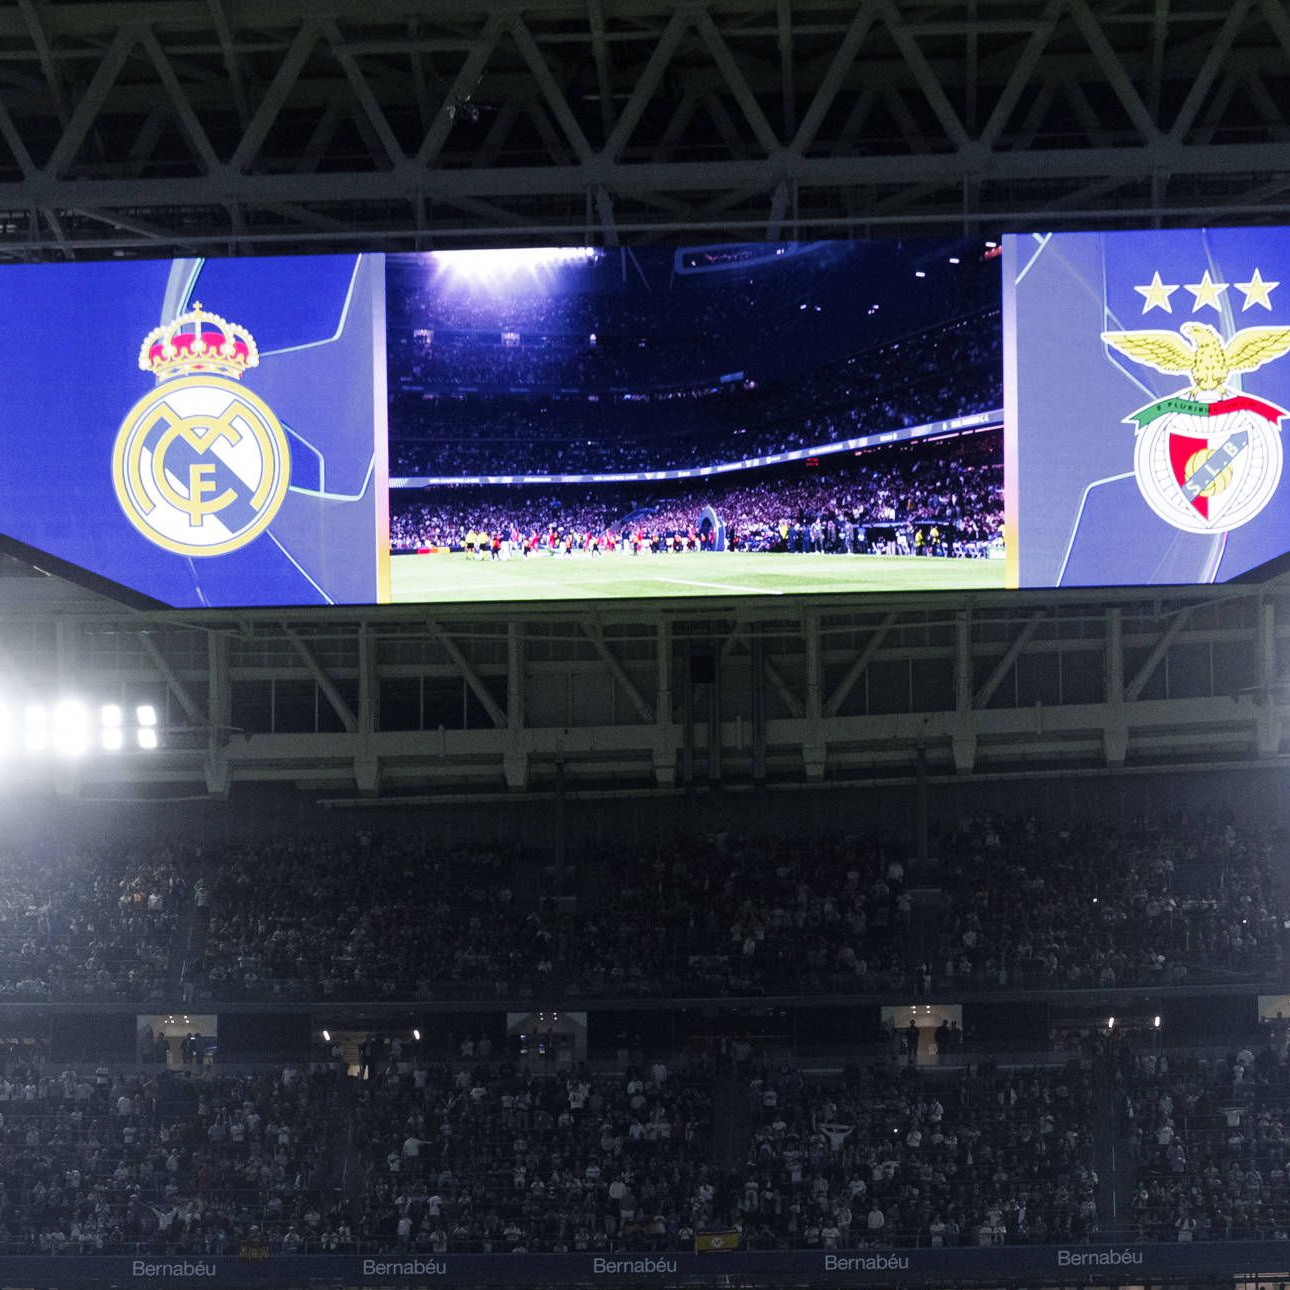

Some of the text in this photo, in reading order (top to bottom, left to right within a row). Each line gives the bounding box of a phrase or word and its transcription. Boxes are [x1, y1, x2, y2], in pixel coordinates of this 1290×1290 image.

[593, 1256, 677, 1276] Bernabéu
[824, 1253, 909, 1272] Bernabéu
[1057, 1248, 1144, 1267] Bernabéu
[132, 1259, 217, 1278] Bernabéu
[362, 1258, 447, 1277] Bernabéu
